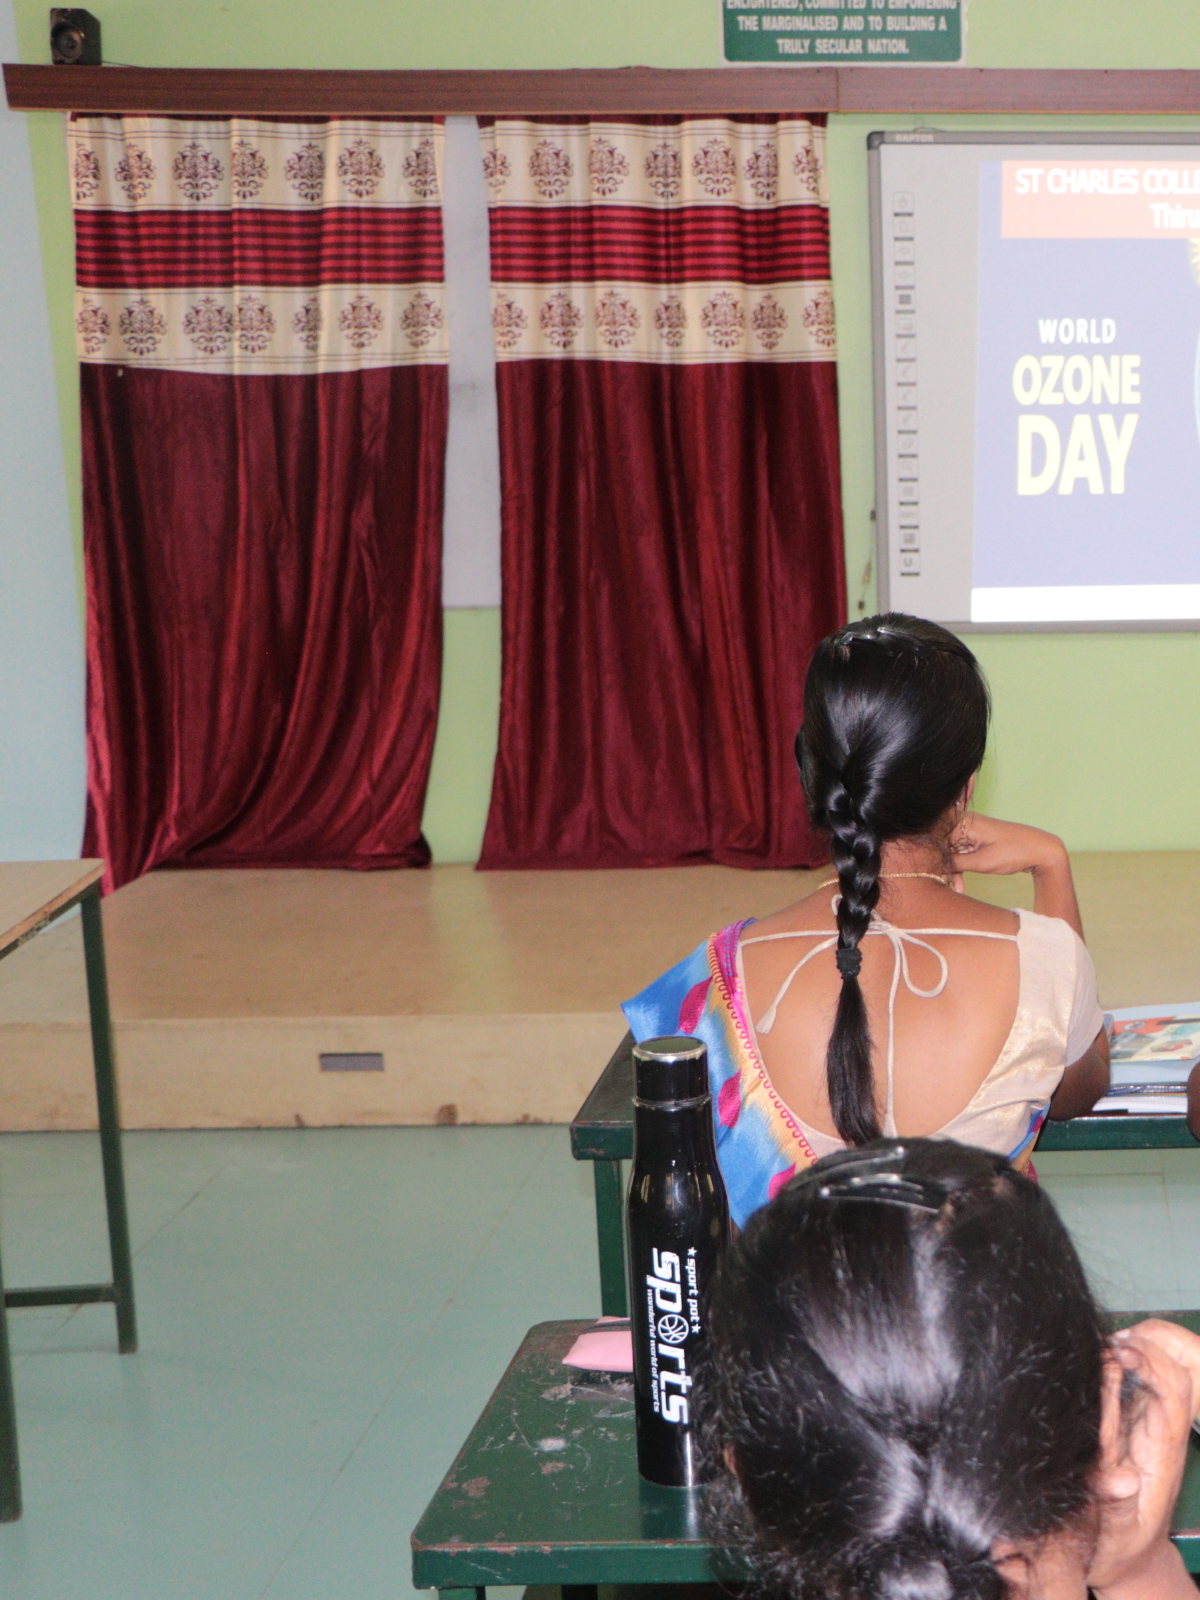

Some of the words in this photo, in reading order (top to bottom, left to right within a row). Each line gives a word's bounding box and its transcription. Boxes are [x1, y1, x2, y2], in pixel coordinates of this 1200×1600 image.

[737, 15, 759, 31] THE
[762, 15, 838, 31] MARGINALISED
[842, 15, 865, 31] AND
[868, 15, 883, 31] TO
[886, 15, 936, 31] BUILDING
[938, 15, 948, 31] A
[777, 38, 811, 54] TRULY
[815, 38, 862, 54] SECULAR
[867, 38, 909, 54] NATION.
[1015, 168, 1044, 194] ST
[1046, 168, 1140, 195] CHARLES
[1038, 317, 1116, 344] WORLD
[1012, 354, 1141, 405] OZONE
[1017, 413, 1139, 495] DAY
[685, 1258, 699, 1296] sport
[647, 1289, 657, 1338] wonderful
[687, 1298, 701, 1322] pot
[650, 1339, 659, 1367] world
[651, 1380, 660, 1412] sports
